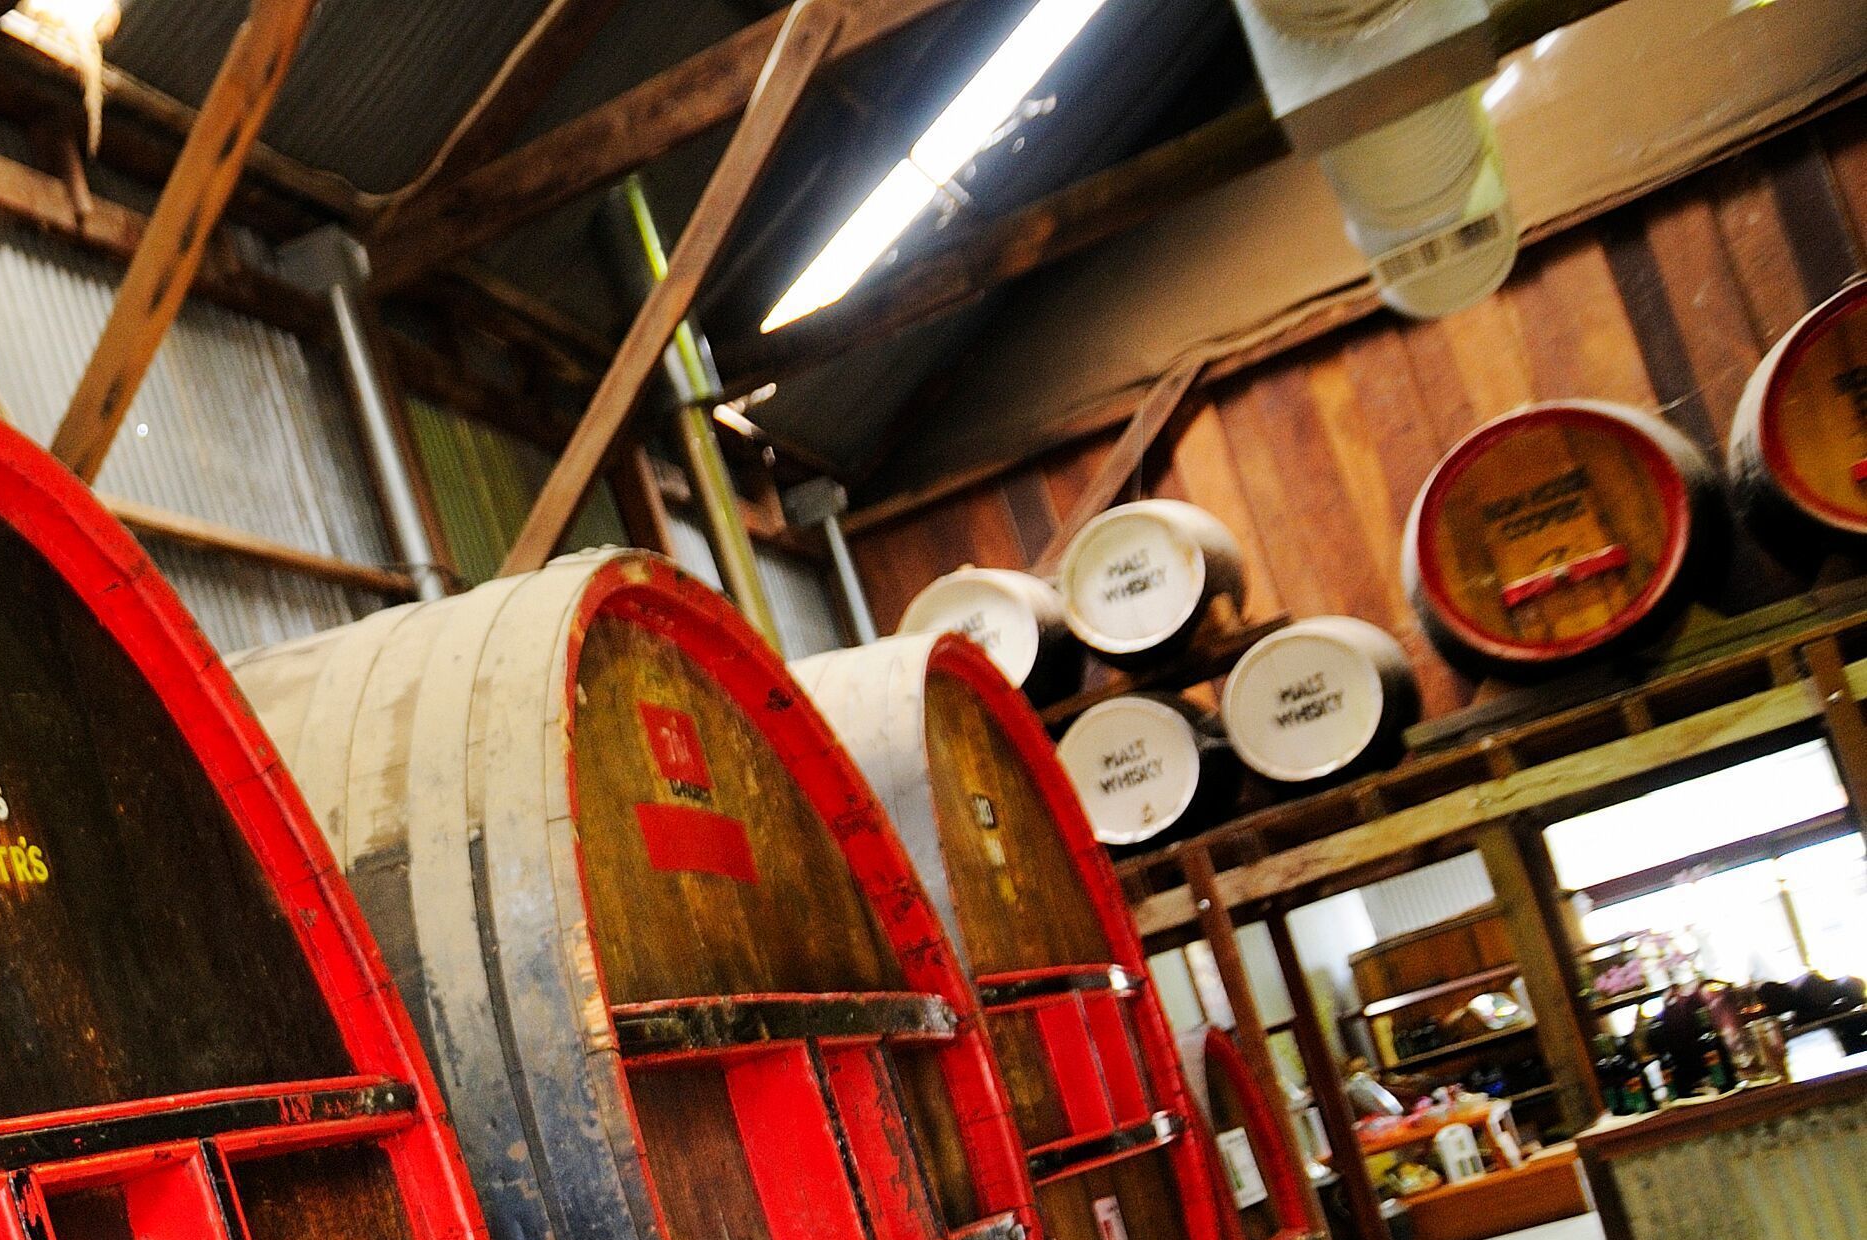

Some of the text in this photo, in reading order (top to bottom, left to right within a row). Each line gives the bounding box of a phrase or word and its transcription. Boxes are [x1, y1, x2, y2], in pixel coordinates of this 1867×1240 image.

[1108, 548, 1150, 577] MALT
[1103, 565, 1167, 602] WHISKY
[1279, 671, 1326, 701] MALT
[1276, 690, 1342, 728] WHISKY
[1102, 738, 1146, 768] MALT
[1099, 757, 1163, 794] WHISKY
